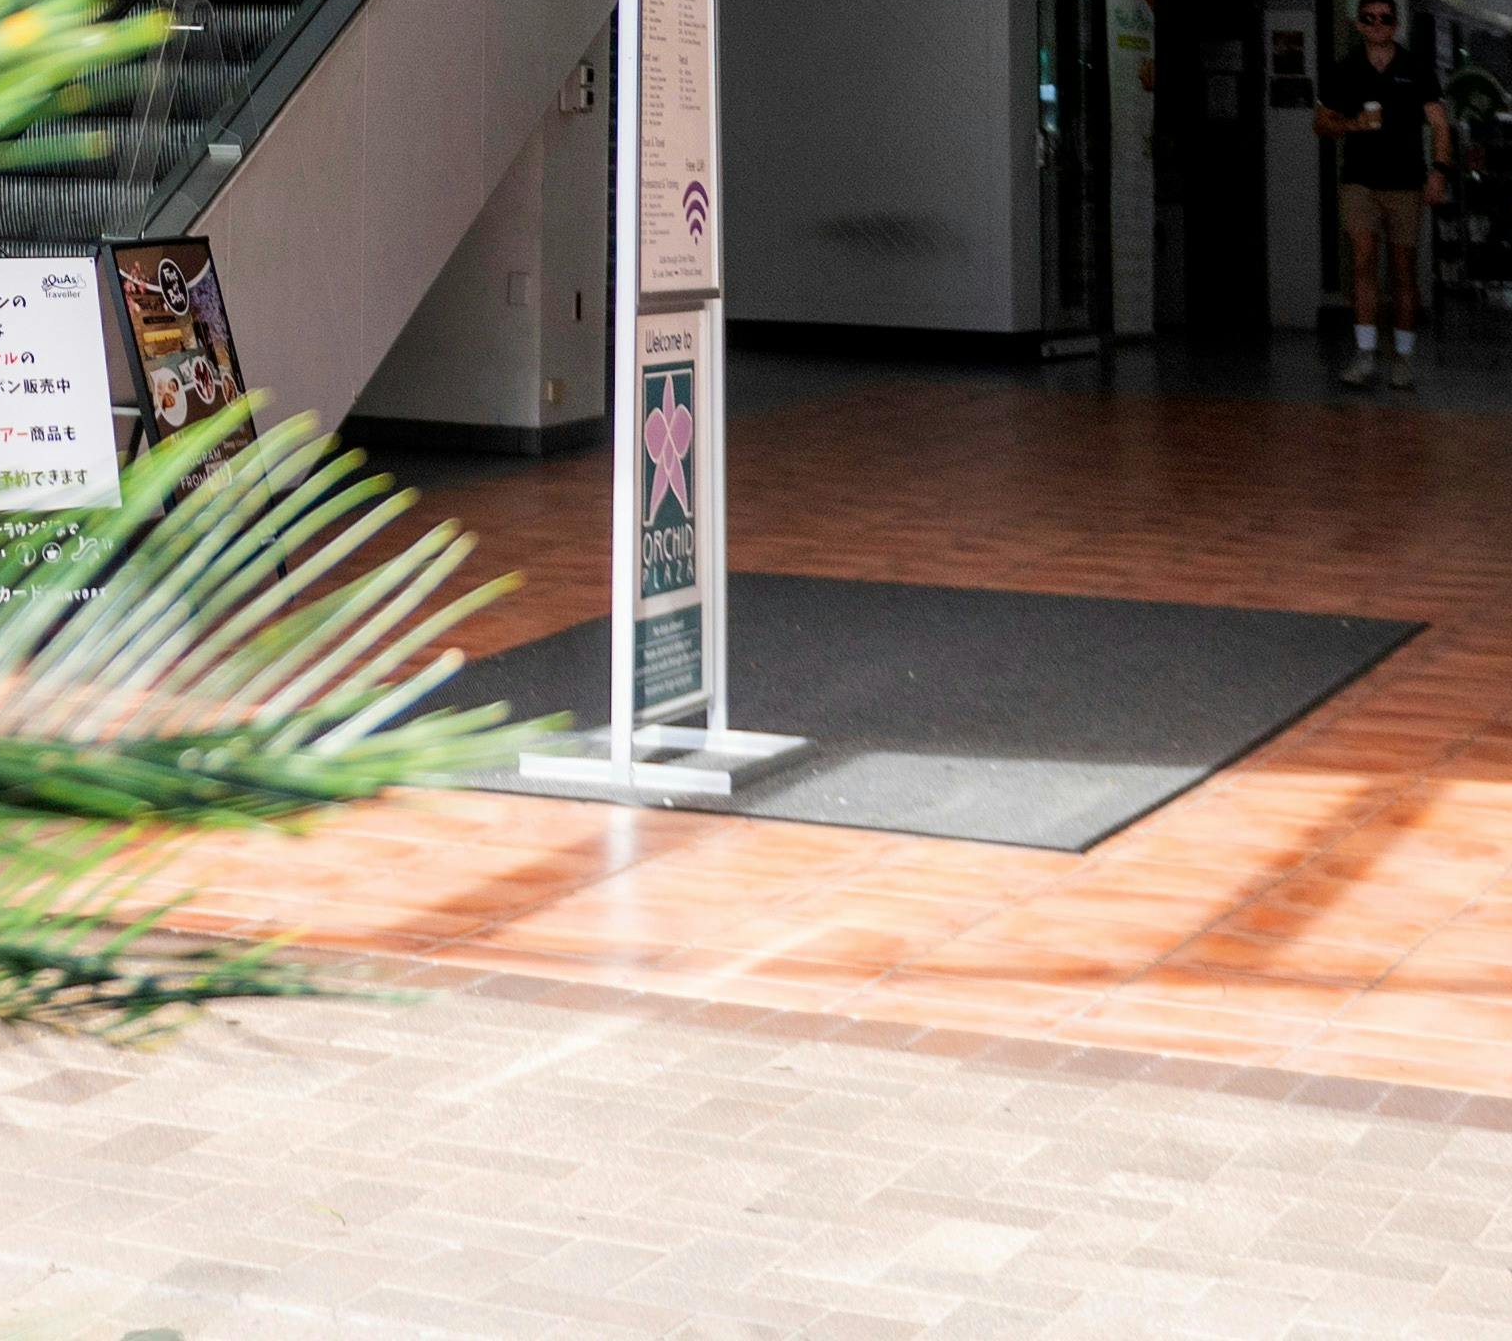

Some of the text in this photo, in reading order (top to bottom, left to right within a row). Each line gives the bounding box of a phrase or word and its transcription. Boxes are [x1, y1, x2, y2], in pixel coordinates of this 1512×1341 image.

[44, 290, 81, 299] Traveller
[645, 330, 693, 353] Welcome to
[642, 523, 694, 566] ORCHID
[642, 557, 694, 590] PLAZA
